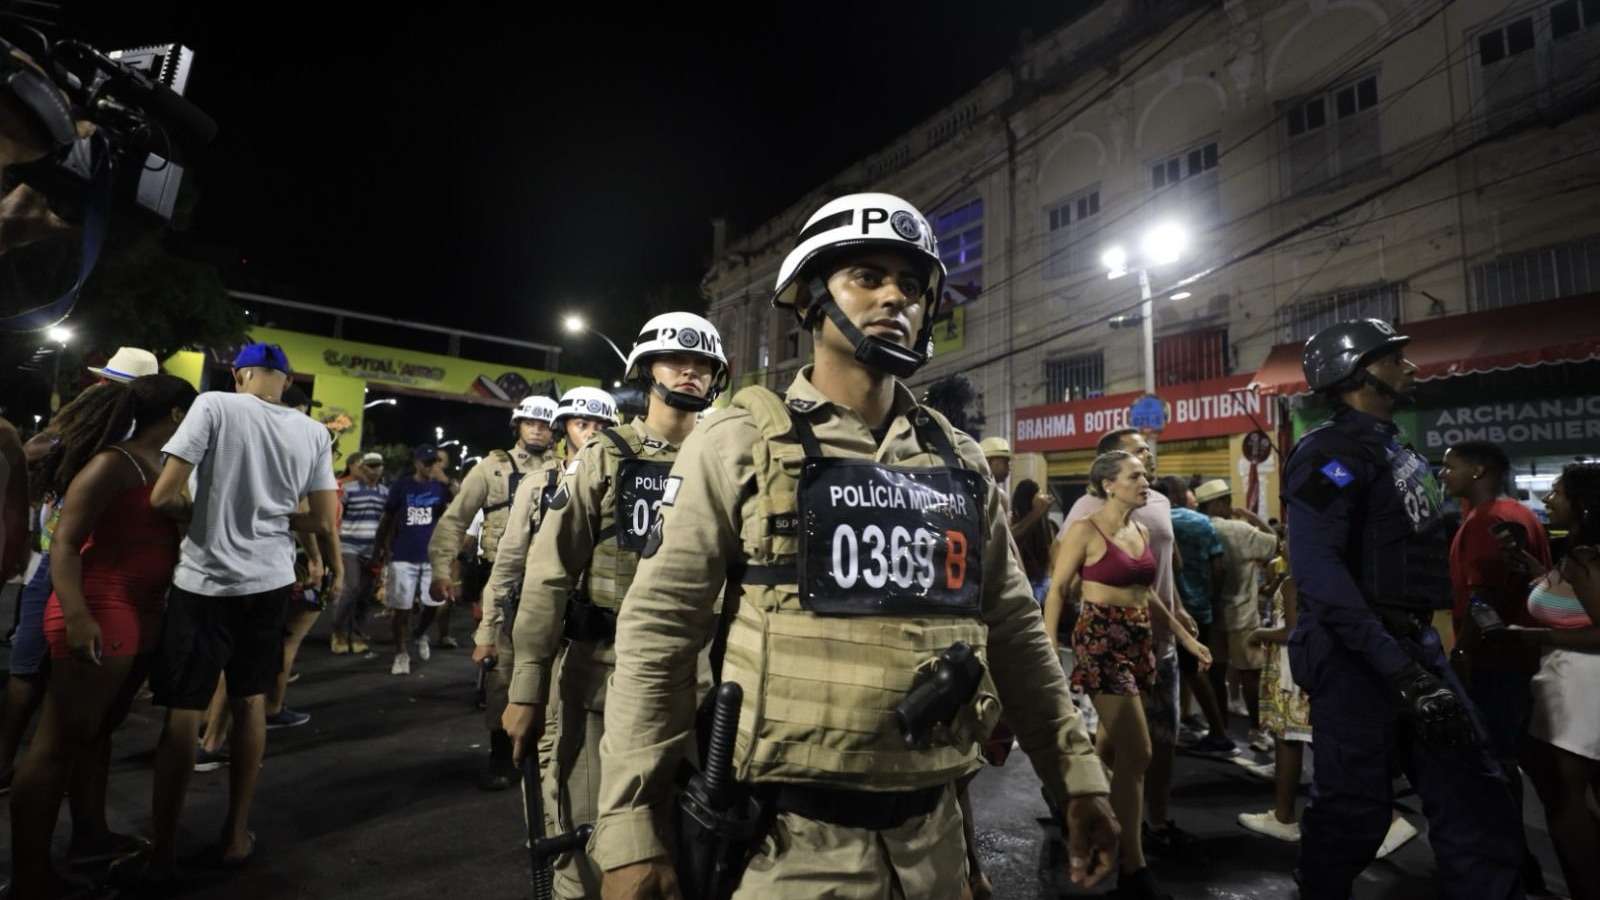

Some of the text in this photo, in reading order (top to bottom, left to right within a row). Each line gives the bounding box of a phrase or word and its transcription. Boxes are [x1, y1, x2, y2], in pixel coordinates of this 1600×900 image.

[1017, 413, 1076, 440] BRAHMA
[1176, 393, 1260, 423] BUTIBAN
[830, 480, 907, 510] POLÍCIA
[832, 523, 968, 589] 0369 B
